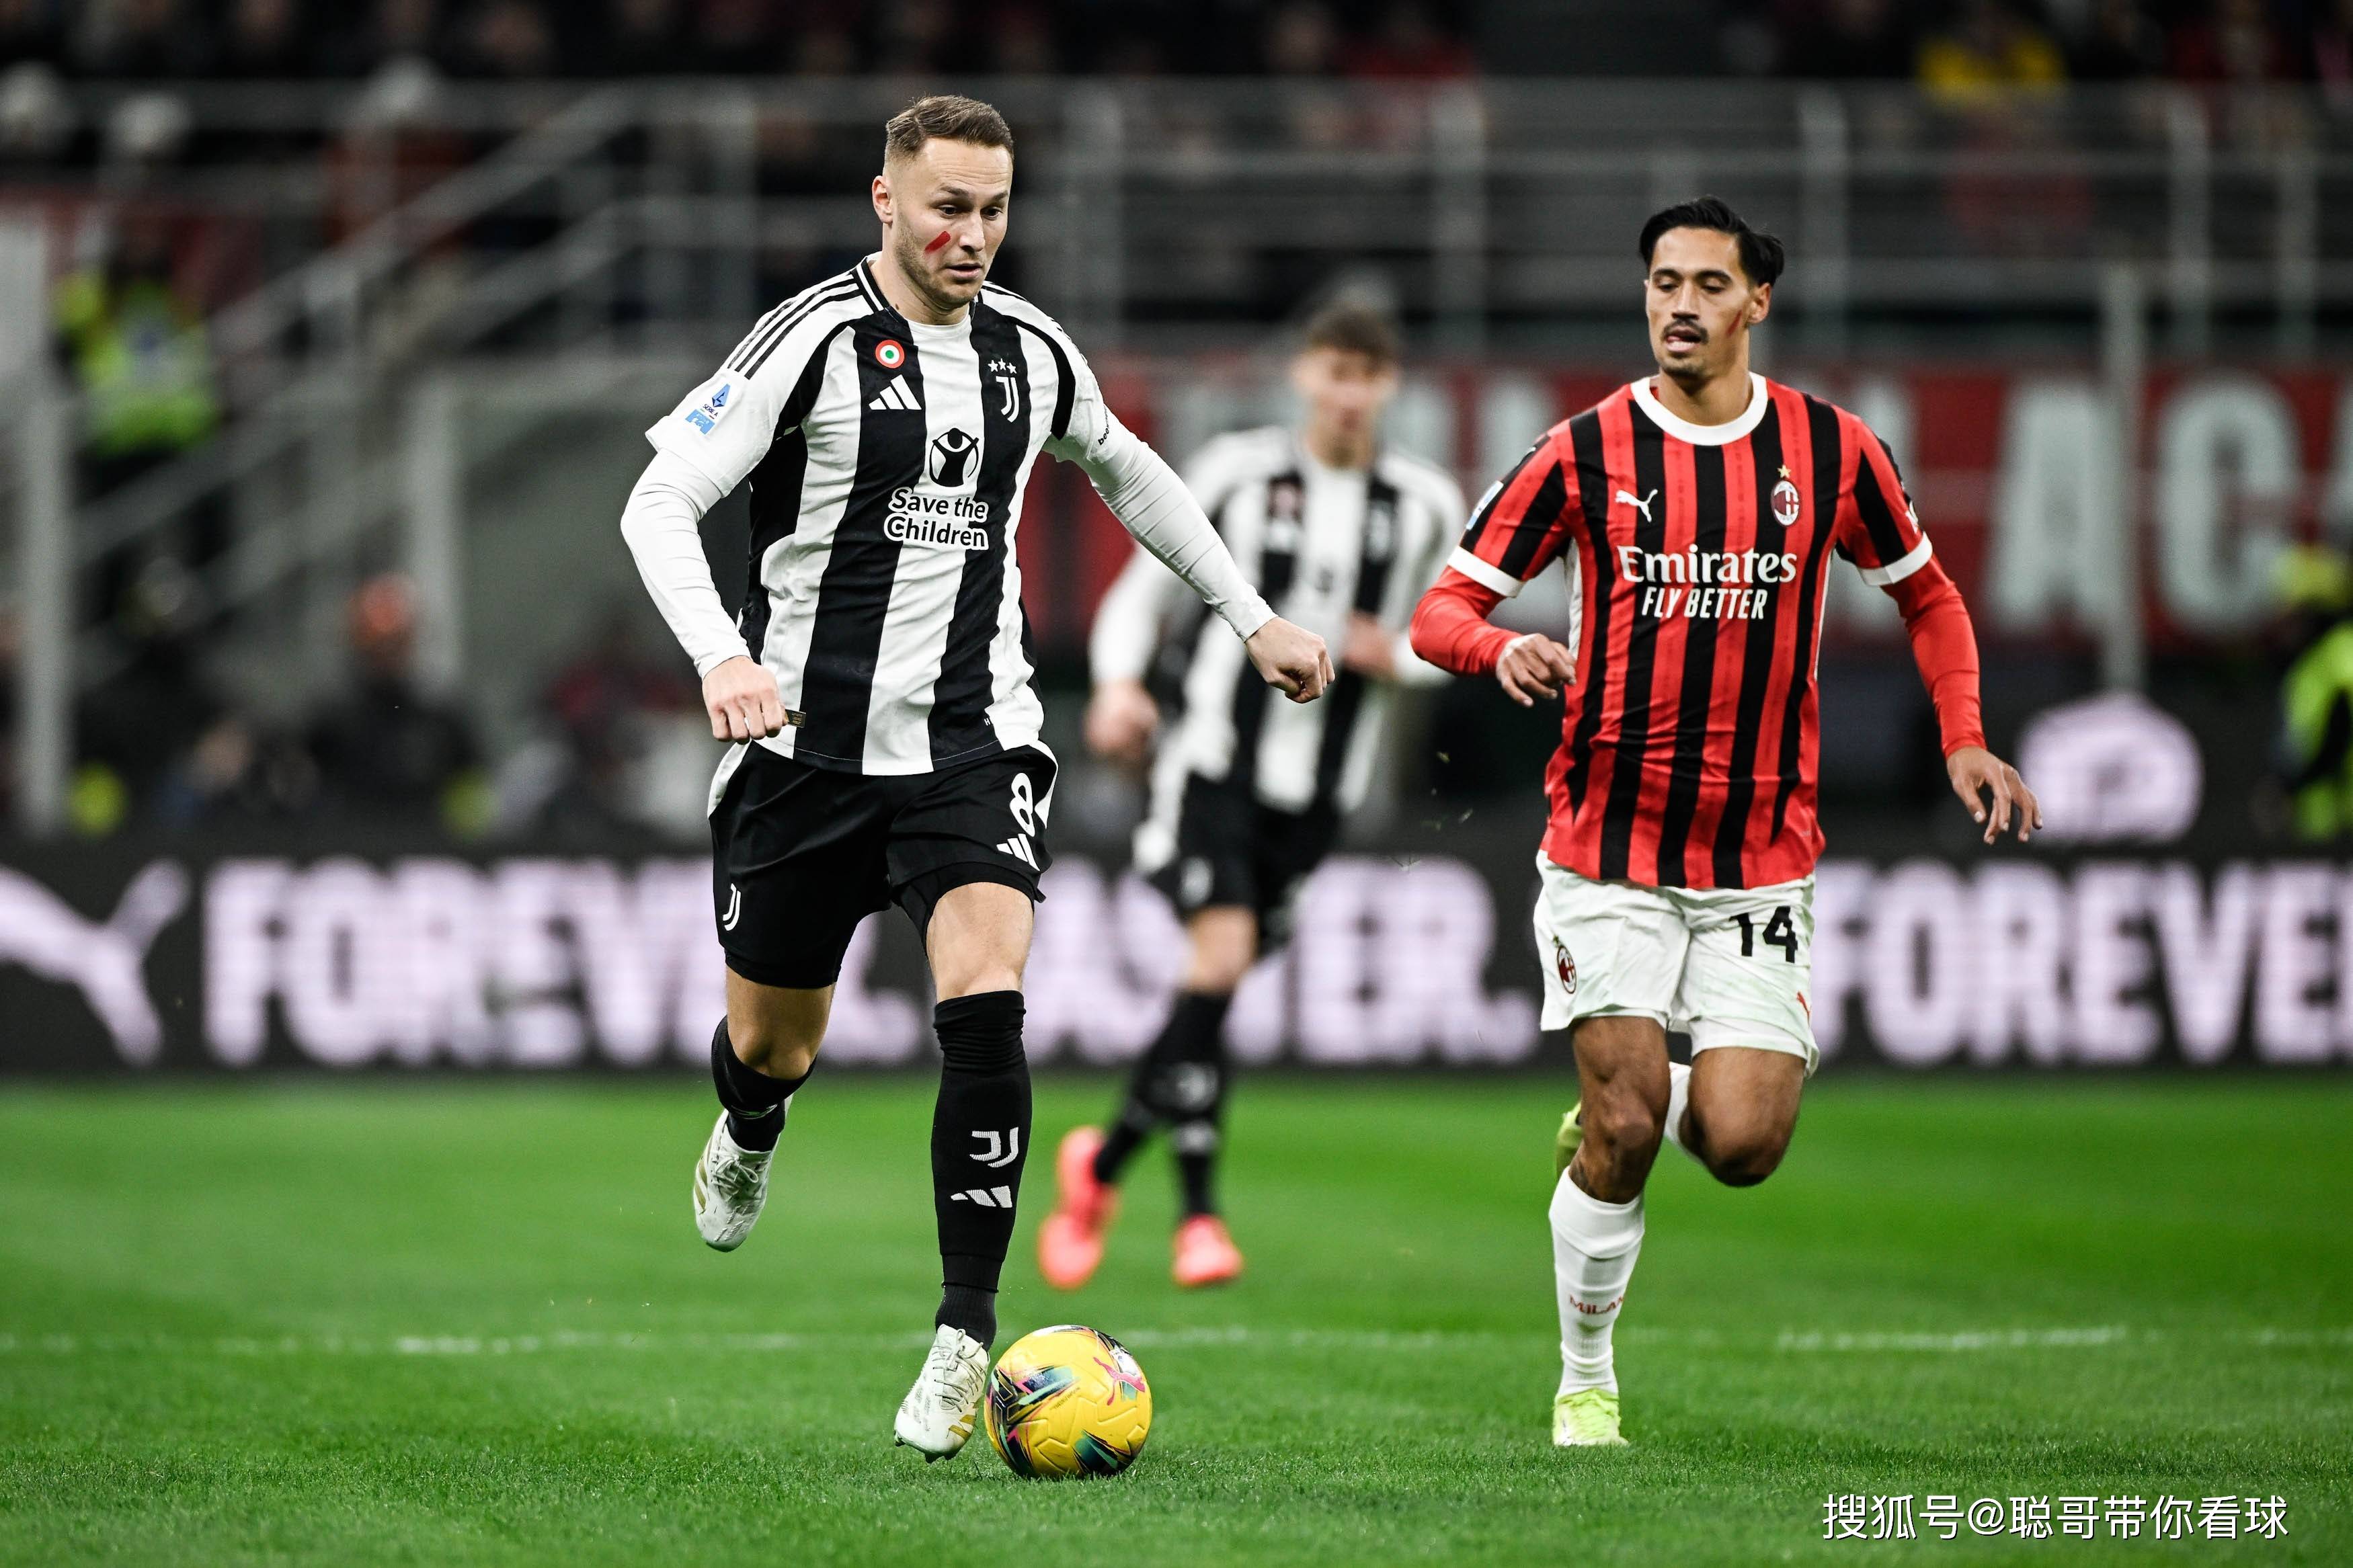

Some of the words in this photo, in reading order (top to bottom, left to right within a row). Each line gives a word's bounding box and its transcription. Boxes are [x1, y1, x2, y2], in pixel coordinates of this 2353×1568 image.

[891, 488, 949, 515] Save
[954, 497, 986, 520] the
[887, 515, 986, 548] Children
[1617, 543, 1798, 583] Emirates
[1641, 586, 1682, 619] FLY
[1683, 587, 1769, 620] BETTER
[1009, 772, 1036, 837] 8
[1728, 905, 1798, 964] 14
[1810, 858, 2353, 1067] FOREVE
